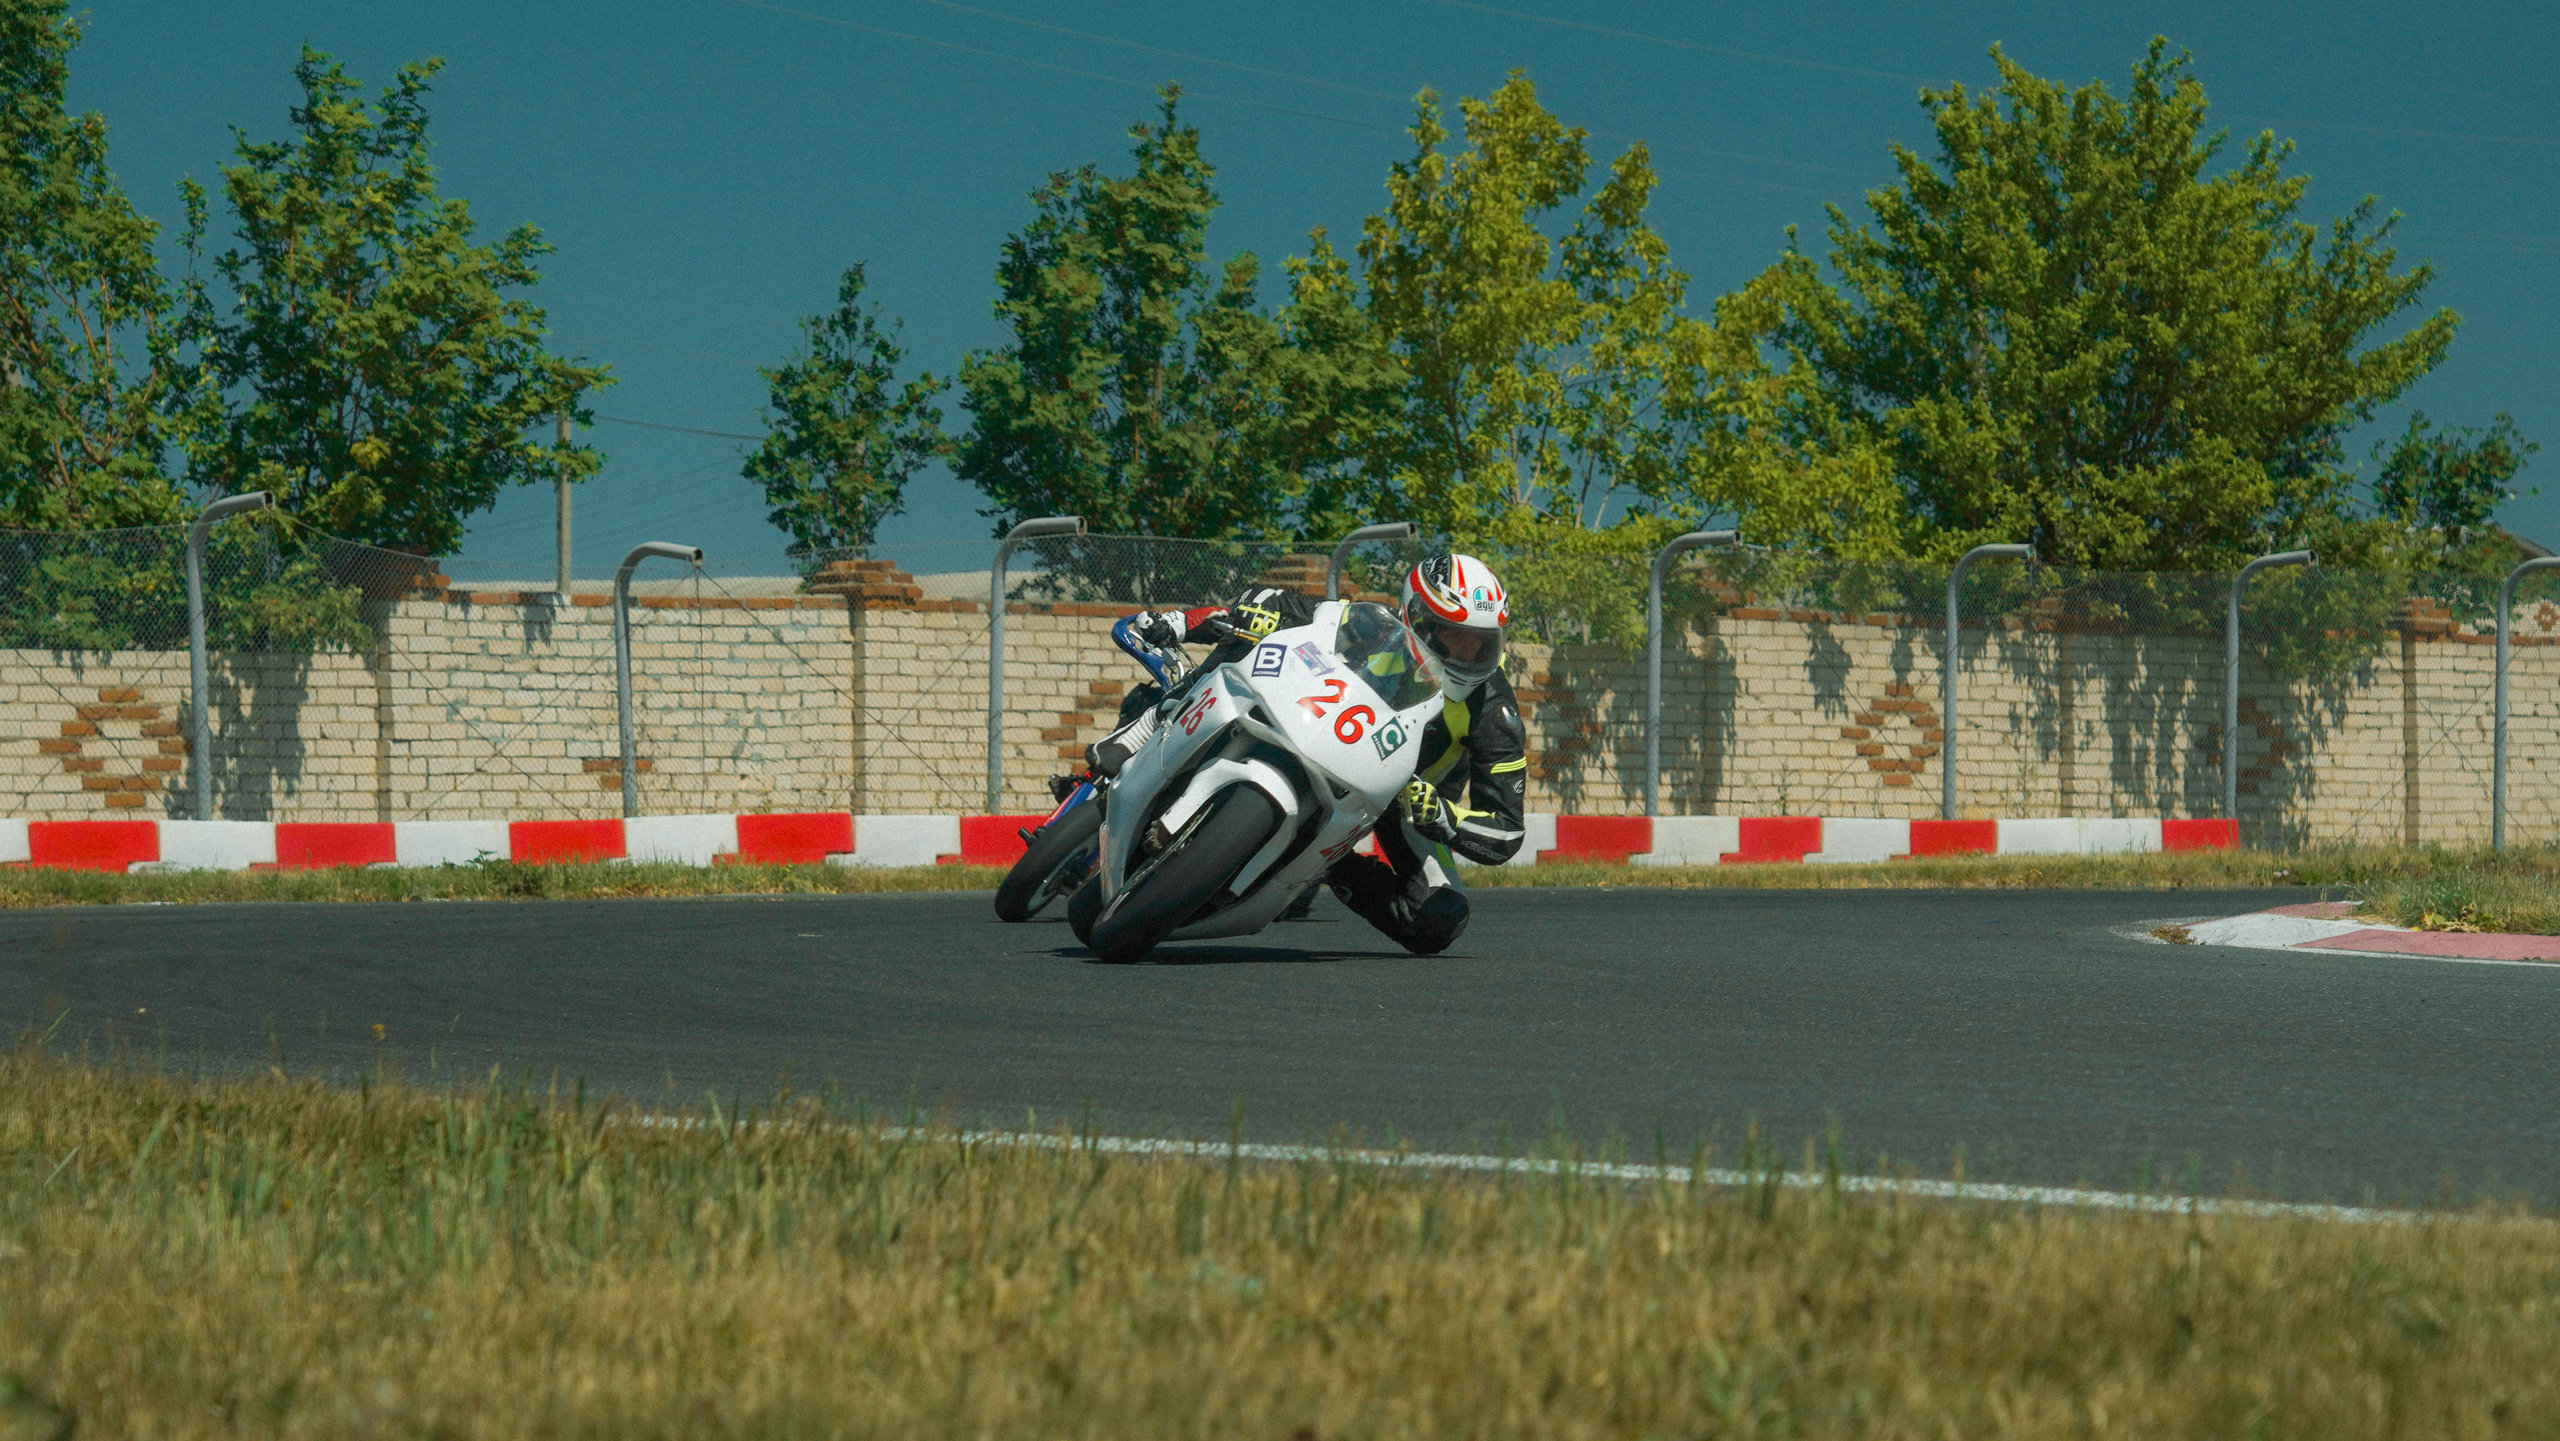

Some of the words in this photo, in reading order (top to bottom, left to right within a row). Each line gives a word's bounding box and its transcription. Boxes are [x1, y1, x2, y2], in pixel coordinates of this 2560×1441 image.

[1256, 647, 1283, 669] B
[1180, 687, 1217, 735] 26
[1297, 679, 1376, 744] 26
[1381, 723, 1402, 751] C
